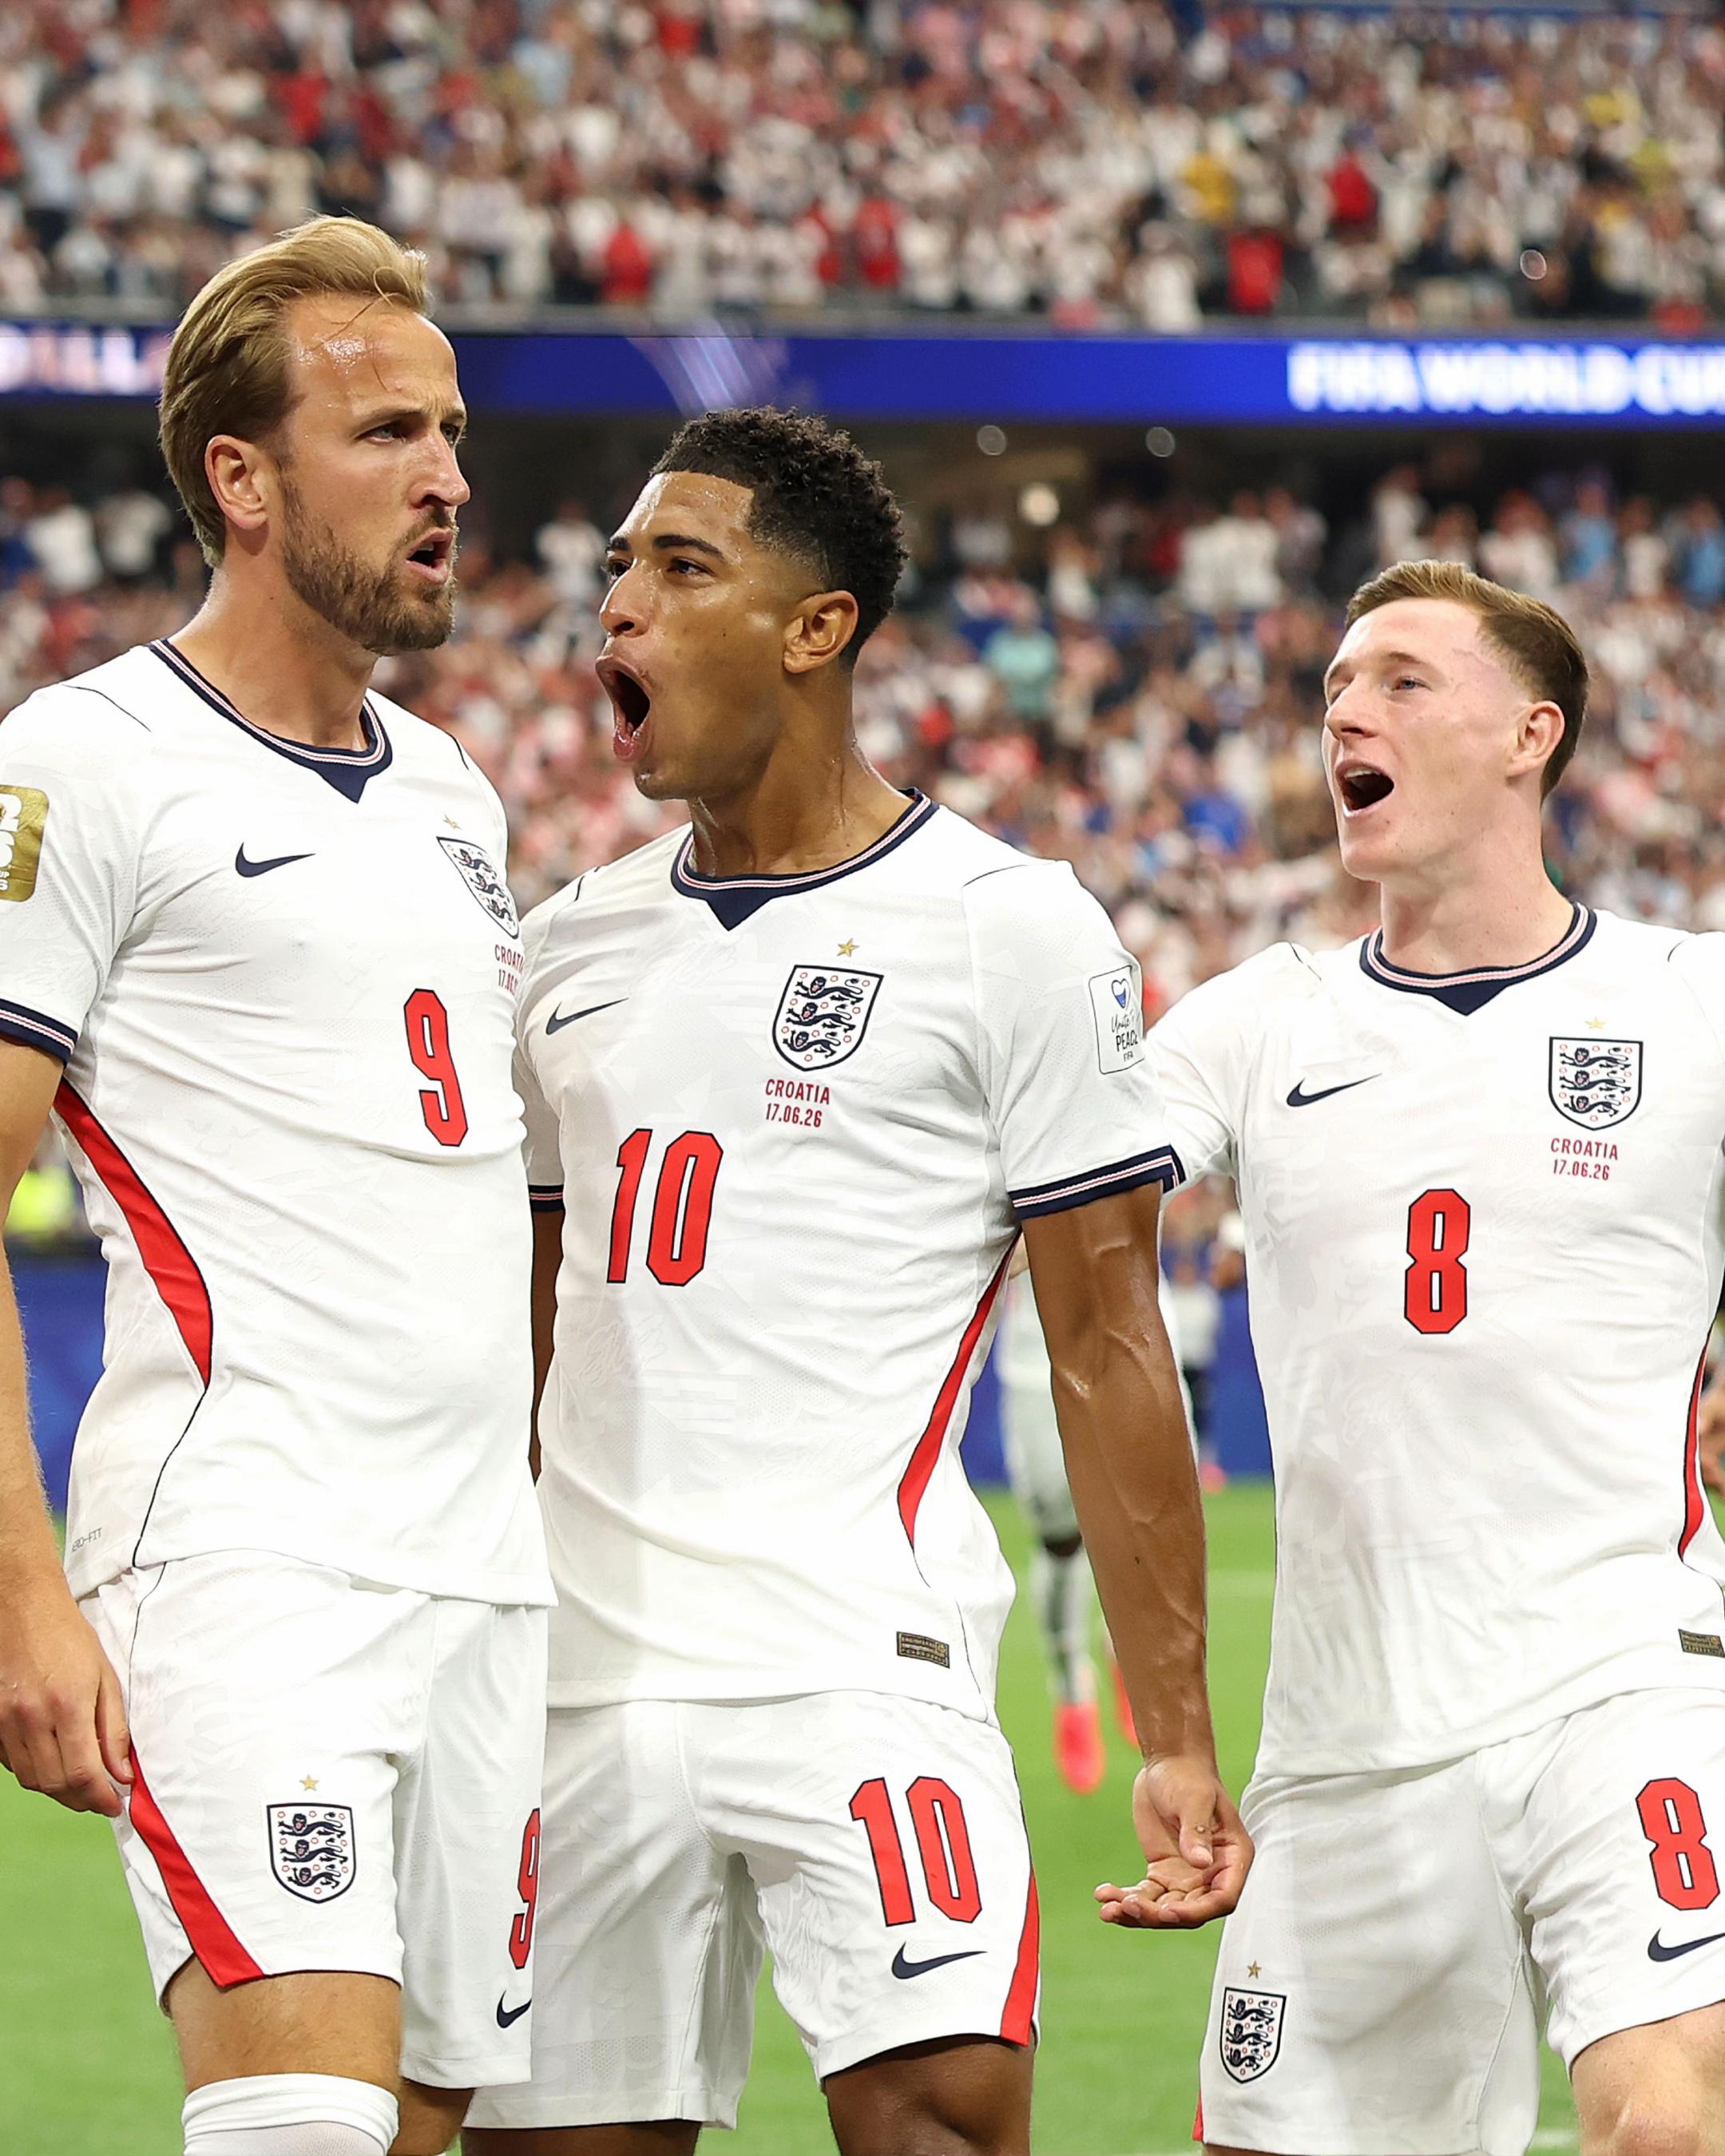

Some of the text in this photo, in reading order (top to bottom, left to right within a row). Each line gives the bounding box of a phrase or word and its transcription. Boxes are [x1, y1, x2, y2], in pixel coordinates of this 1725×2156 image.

[1288, 343, 1421, 411] FIFA
[1418, 343, 1630, 414] WORLD
[495, 945, 524, 973] CROATI
[403, 988, 469, 1147] 9
[765, 1078, 830, 1104] CROATIA
[766, 1103, 823, 1128] 17.06.26
[1551, 1138, 1618, 1160] CROATIA
[1553, 1159, 1610, 1181] 17.06.26
[607, 1128, 724, 1286] 10
[1404, 1188, 1470, 1334] 8
[509, 1808, 541, 1970] 9
[848, 1775, 982, 1928] 10
[1635, 1777, 1720, 1912] 8
